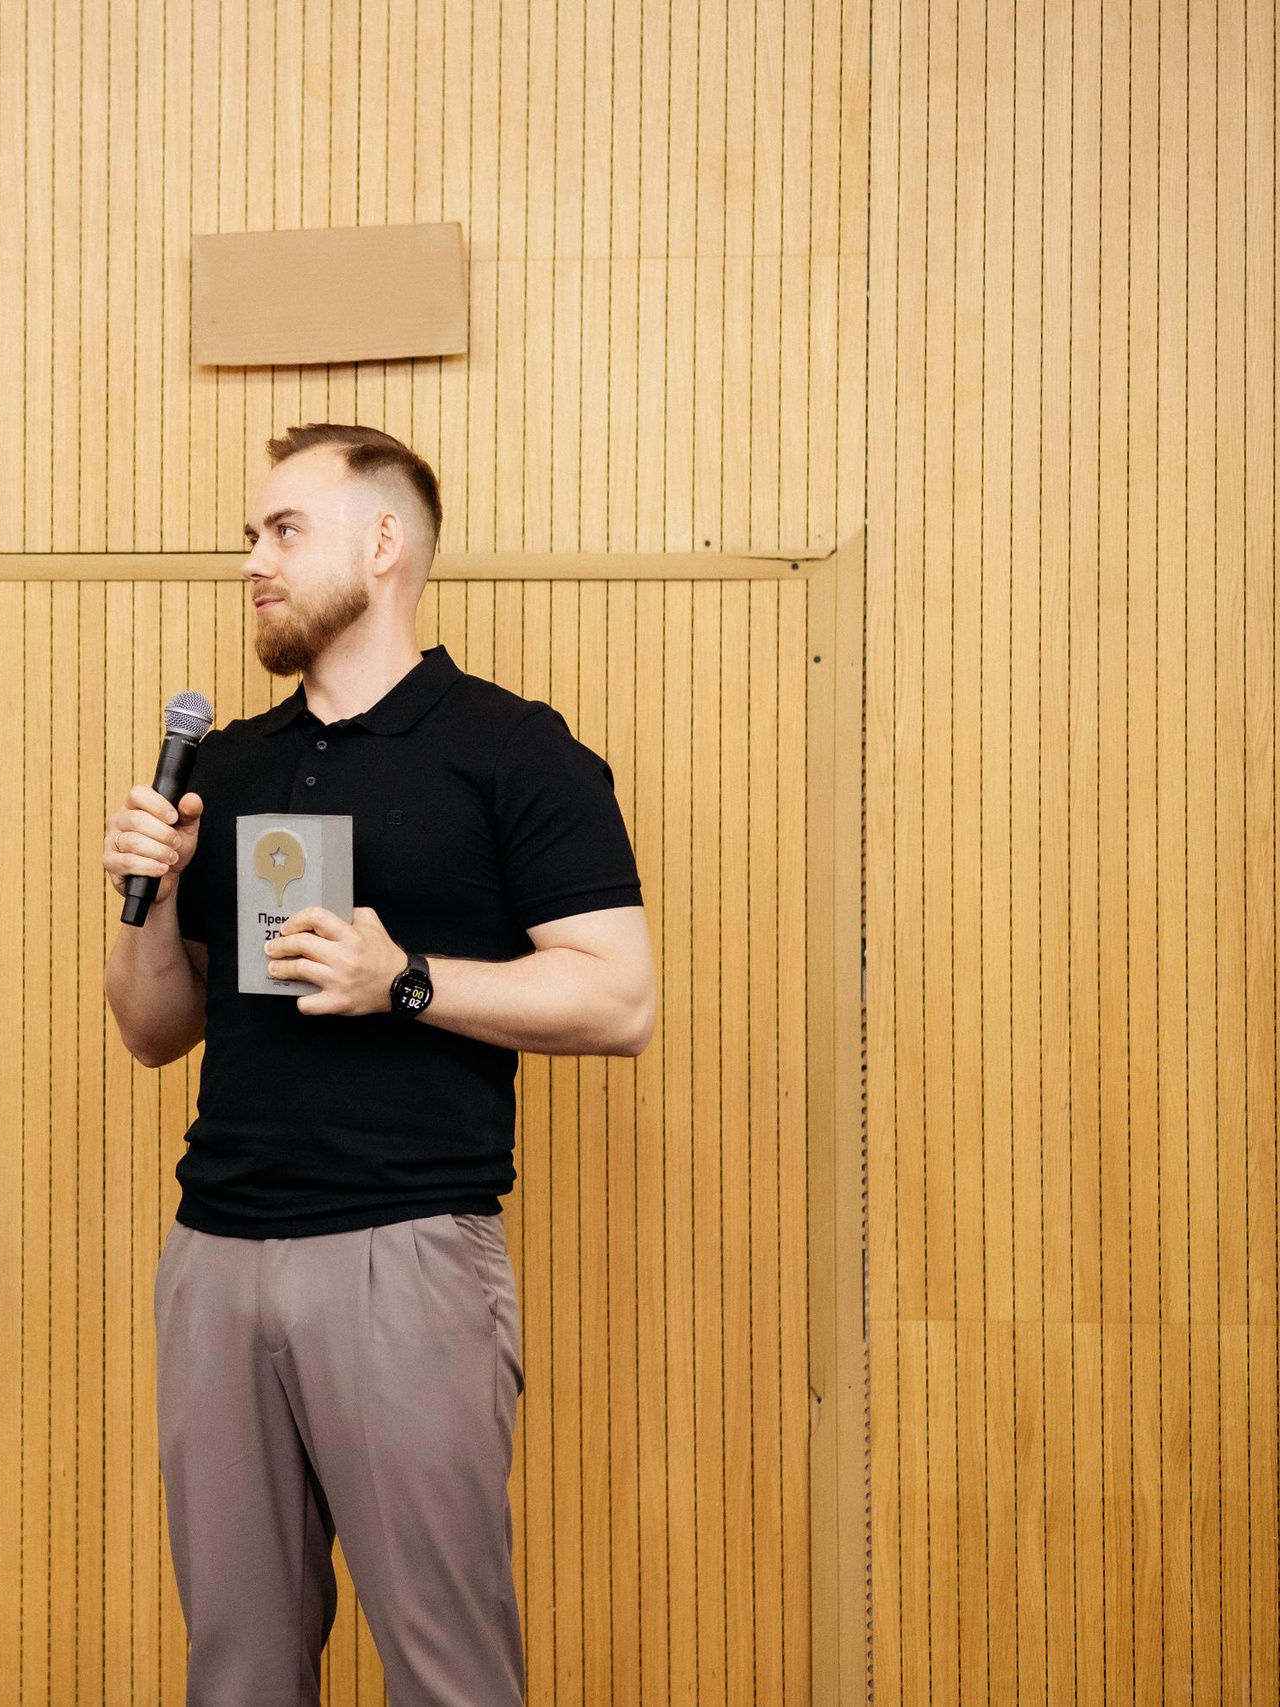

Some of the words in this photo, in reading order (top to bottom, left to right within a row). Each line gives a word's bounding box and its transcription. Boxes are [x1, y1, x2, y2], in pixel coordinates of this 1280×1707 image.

[258, 913, 289, 926] Прем
[265, 930, 284, 940] 2Г
[412, 989, 424, 999] 00
[408, 998, 421, 1009] 20
